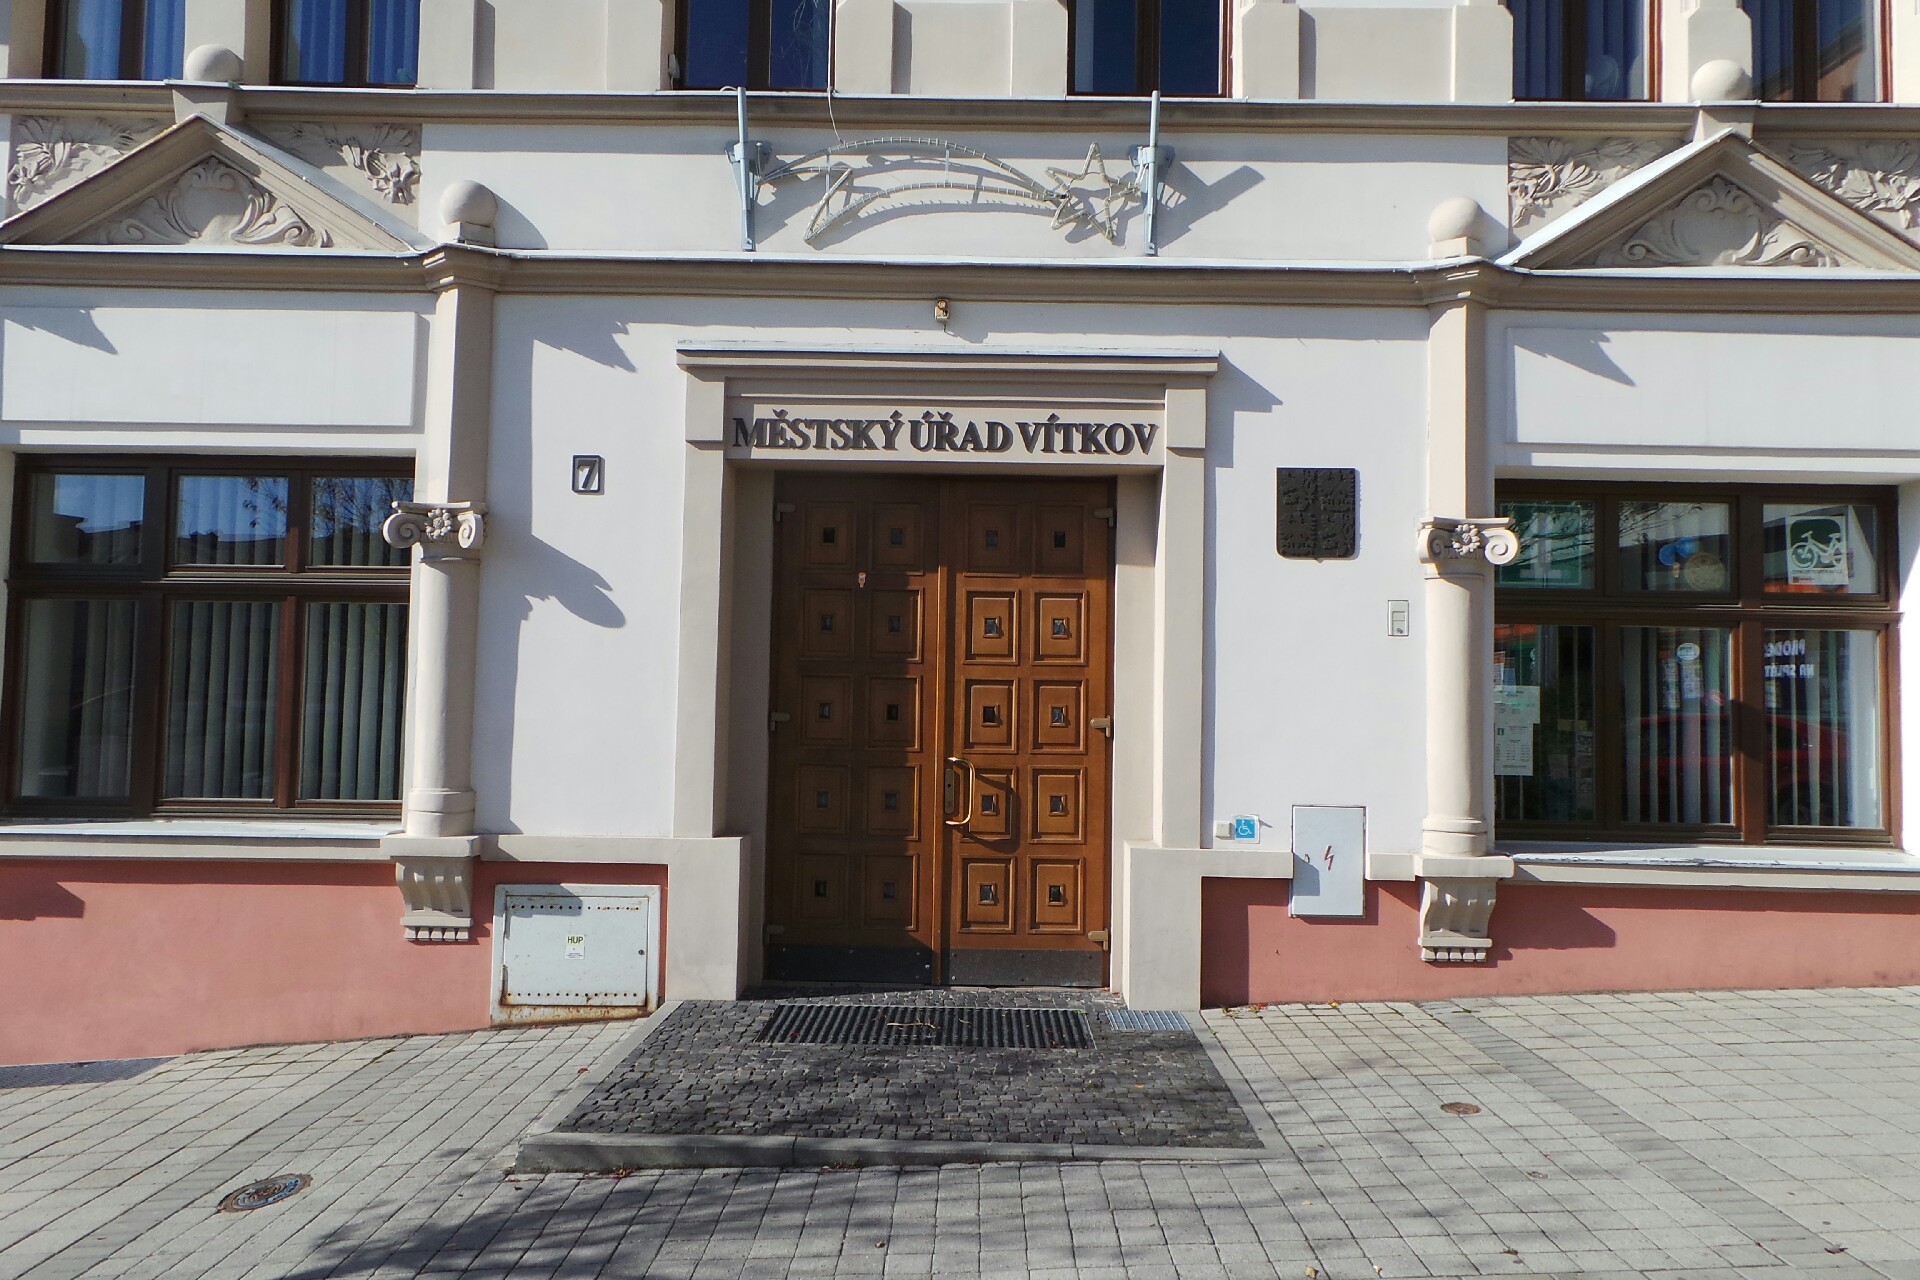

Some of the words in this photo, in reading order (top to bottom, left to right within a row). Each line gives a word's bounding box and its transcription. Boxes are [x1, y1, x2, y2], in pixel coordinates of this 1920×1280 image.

[733, 409, 905, 450] MĚSTSKÝ
[908, 410, 1014, 452] ÚŘAD
[1015, 413, 1159, 455] VÍTKOV
[577, 459, 598, 489] 7
[567, 935, 584, 944] HUP
